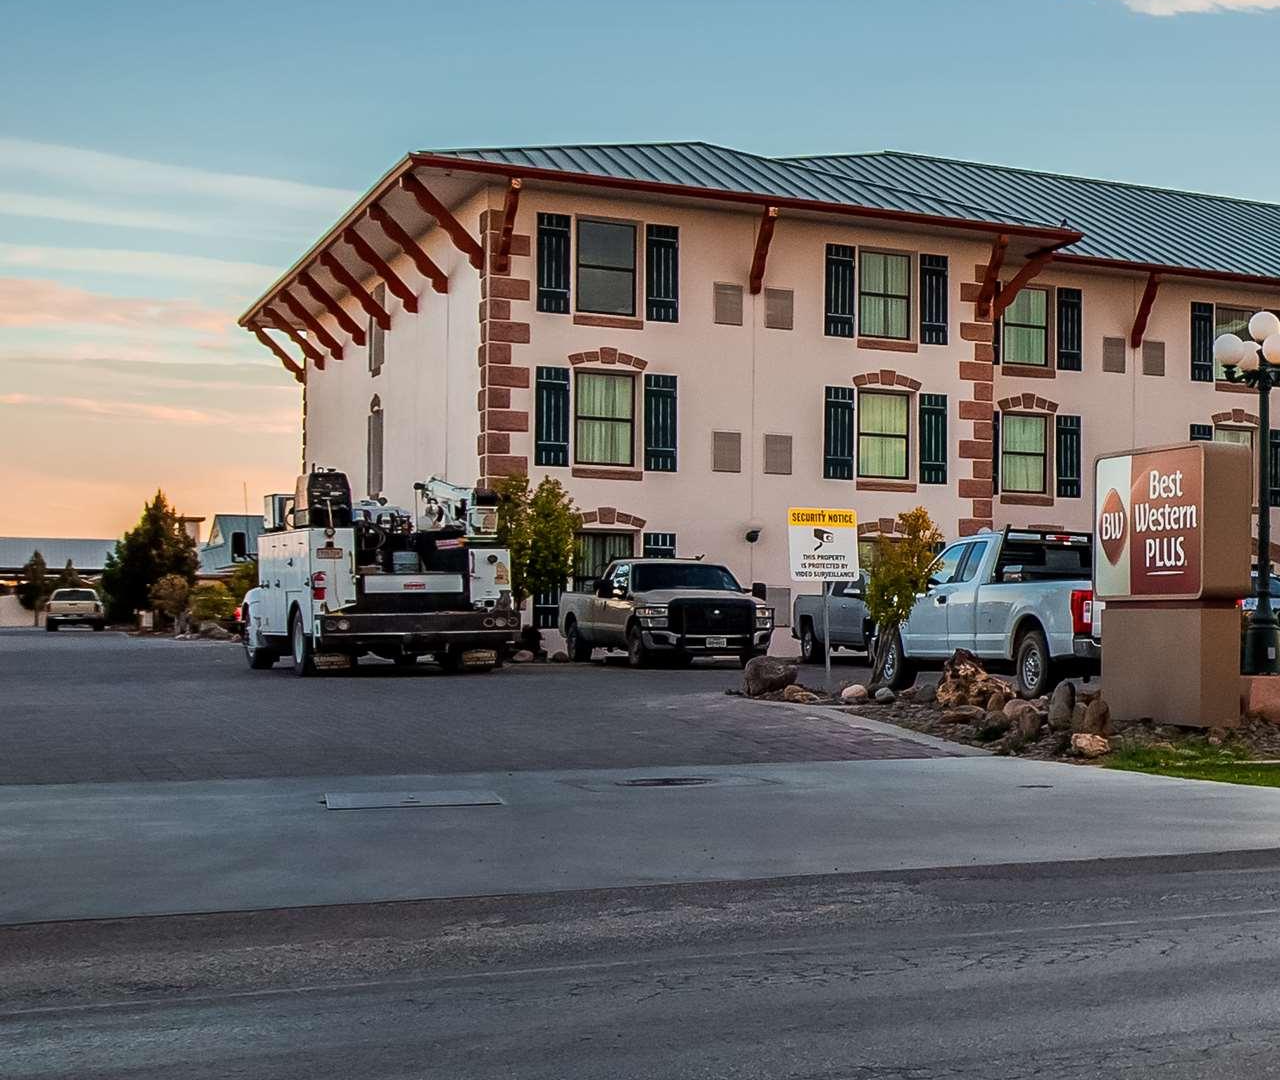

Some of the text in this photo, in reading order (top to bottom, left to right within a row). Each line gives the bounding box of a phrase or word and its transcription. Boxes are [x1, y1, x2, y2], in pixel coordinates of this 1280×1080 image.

[1149, 470, 1184, 499] Best
[792, 512, 853, 523] SECURITY NOTICE
[1102, 512, 1124, 540] BW
[1134, 502, 1197, 532] Western
